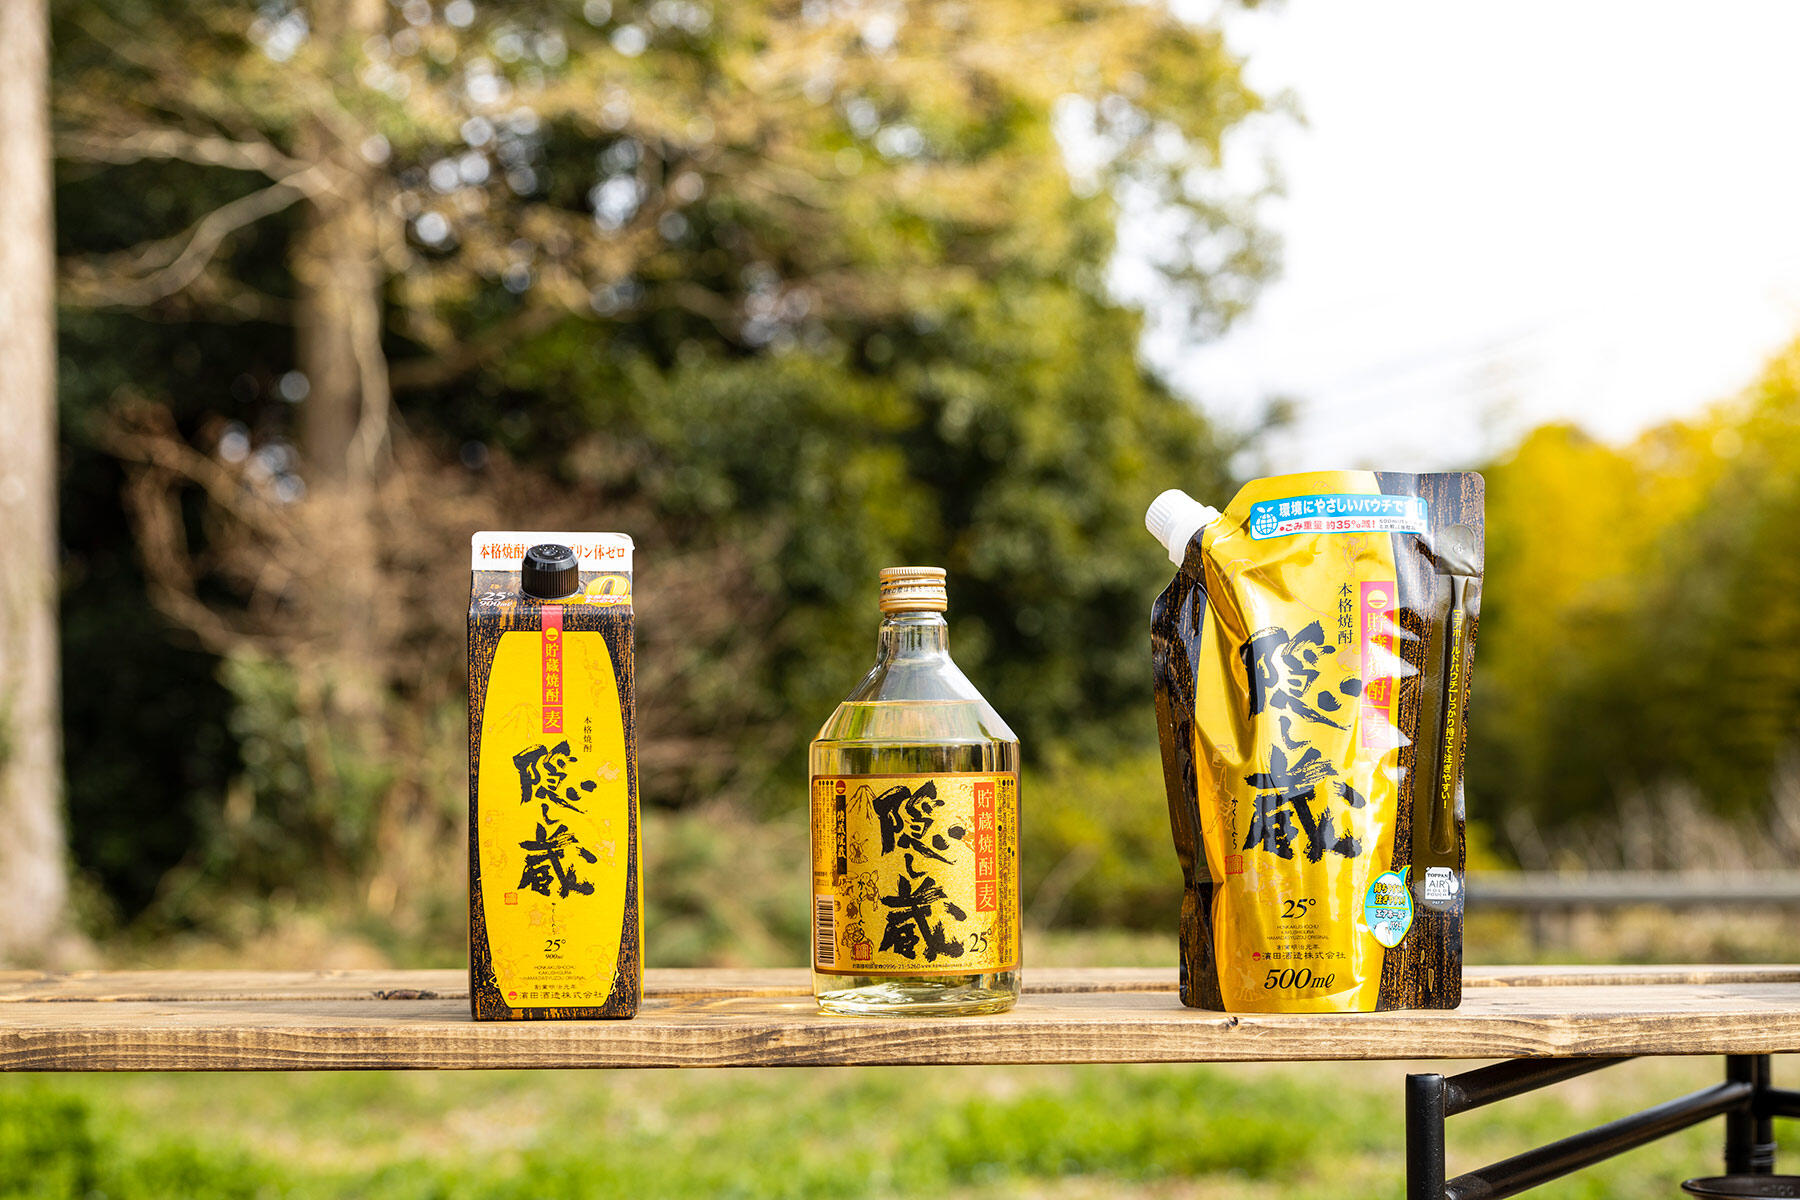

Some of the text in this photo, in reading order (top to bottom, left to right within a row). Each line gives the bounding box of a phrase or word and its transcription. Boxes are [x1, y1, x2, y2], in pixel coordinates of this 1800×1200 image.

[1337, 582, 1354, 645] 本格焼酎
[544, 643, 562, 729] 貯蔵焼酎 麦
[1240, 620, 1366, 864] 隠し蔵
[513, 740, 597, 899] 隠し蔵
[977, 789, 994, 910] 貯蔵焼酎 麦
[872, 779, 966, 963] 隠し蔵
[1429, 880, 1446, 889] AIR
[544, 939, 566, 952] 25°
[969, 928, 992, 953] 25°
[1281, 898, 1316, 919] 25°
